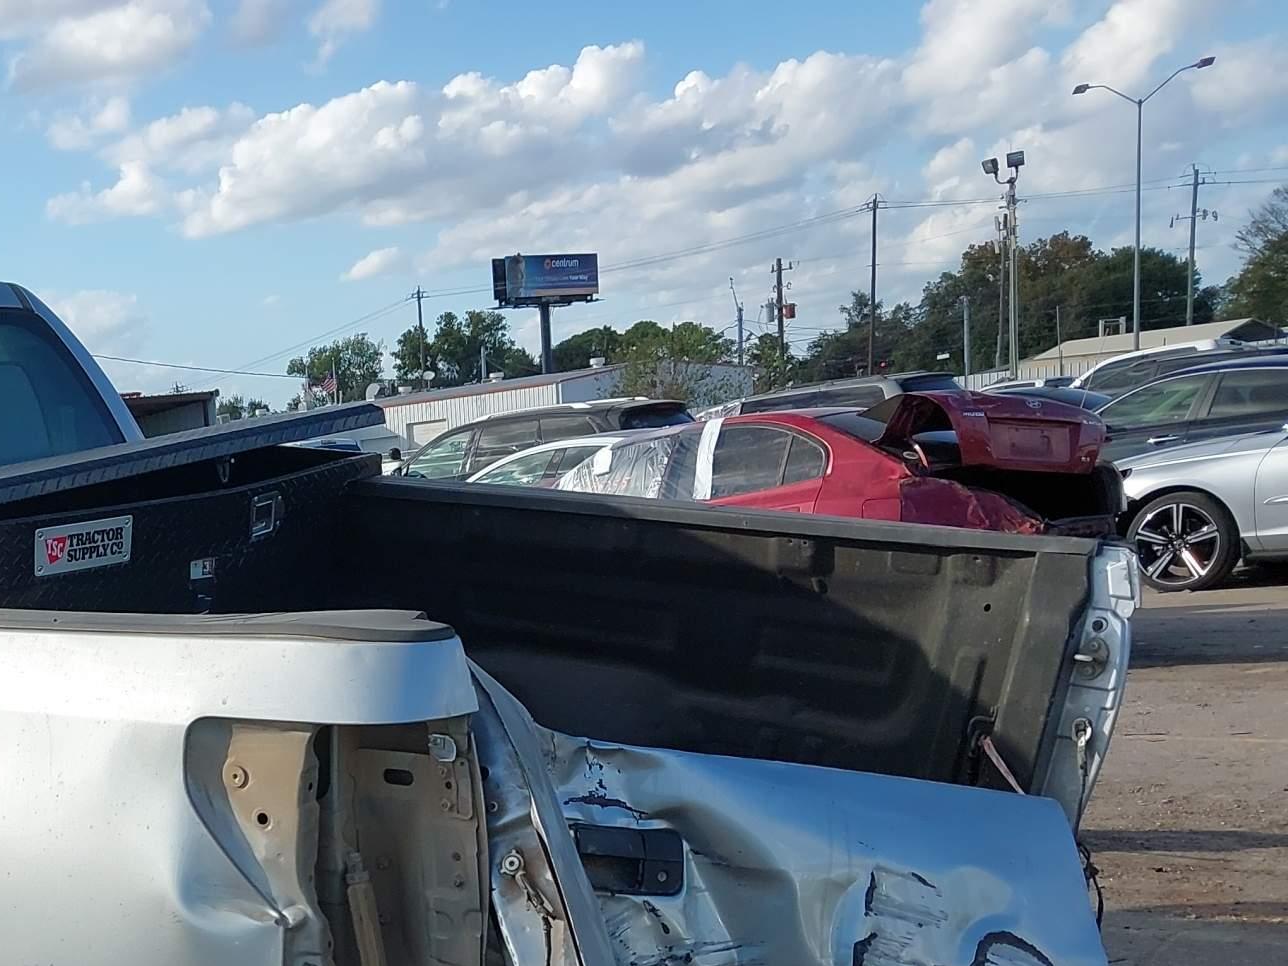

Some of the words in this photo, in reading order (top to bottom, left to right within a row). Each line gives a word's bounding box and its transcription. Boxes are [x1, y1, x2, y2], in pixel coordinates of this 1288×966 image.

[551, 257, 579, 268] centrum
[67, 526, 124, 548] TRACTOR
[46, 539, 64, 558] TSC
[66, 543, 111, 563] SUPPLY
